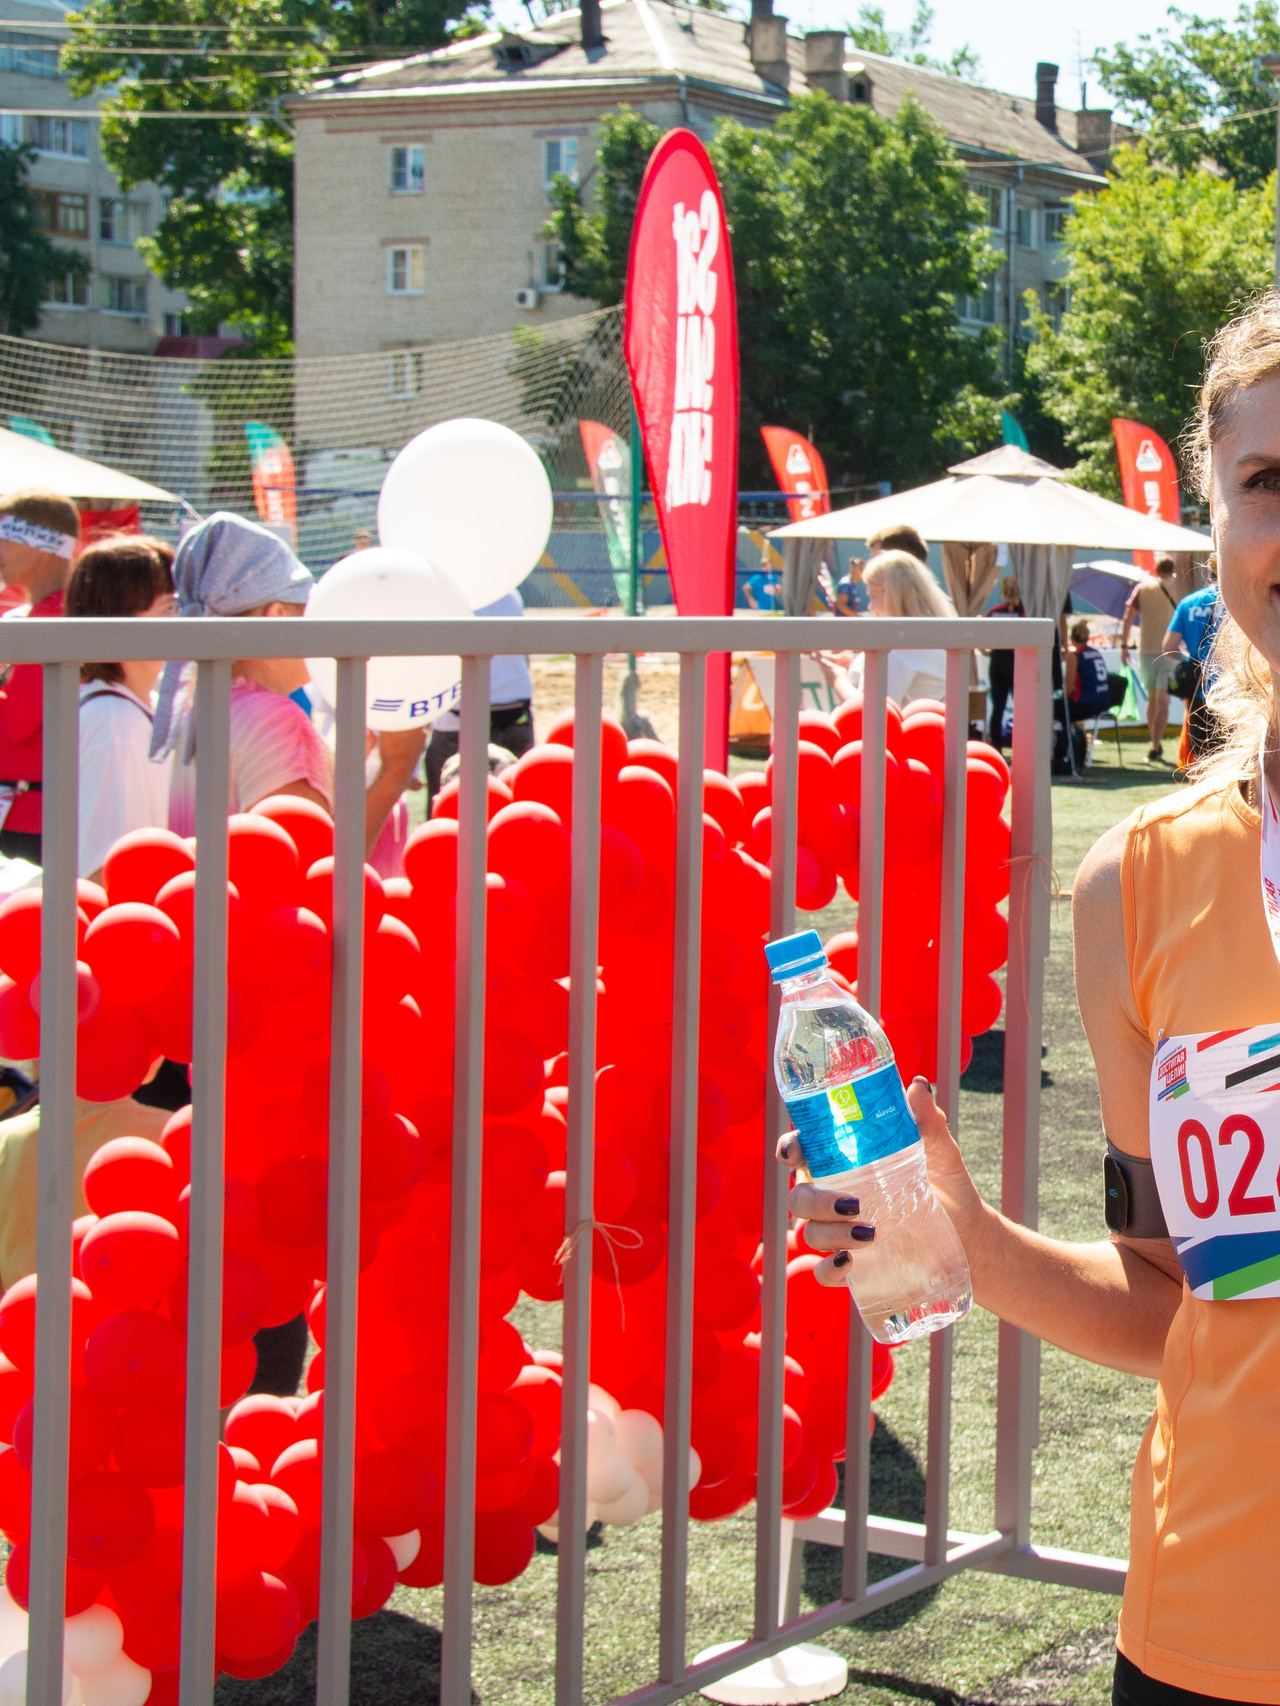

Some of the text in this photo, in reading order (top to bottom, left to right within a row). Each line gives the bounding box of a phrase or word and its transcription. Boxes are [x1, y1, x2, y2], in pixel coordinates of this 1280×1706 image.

[1159, 1051, 1185, 1079] ДОСТИГАЯ
[1166, 1064, 1185, 1085] ЦЕЛИ!
[875, 1105, 897, 1119] slavda
